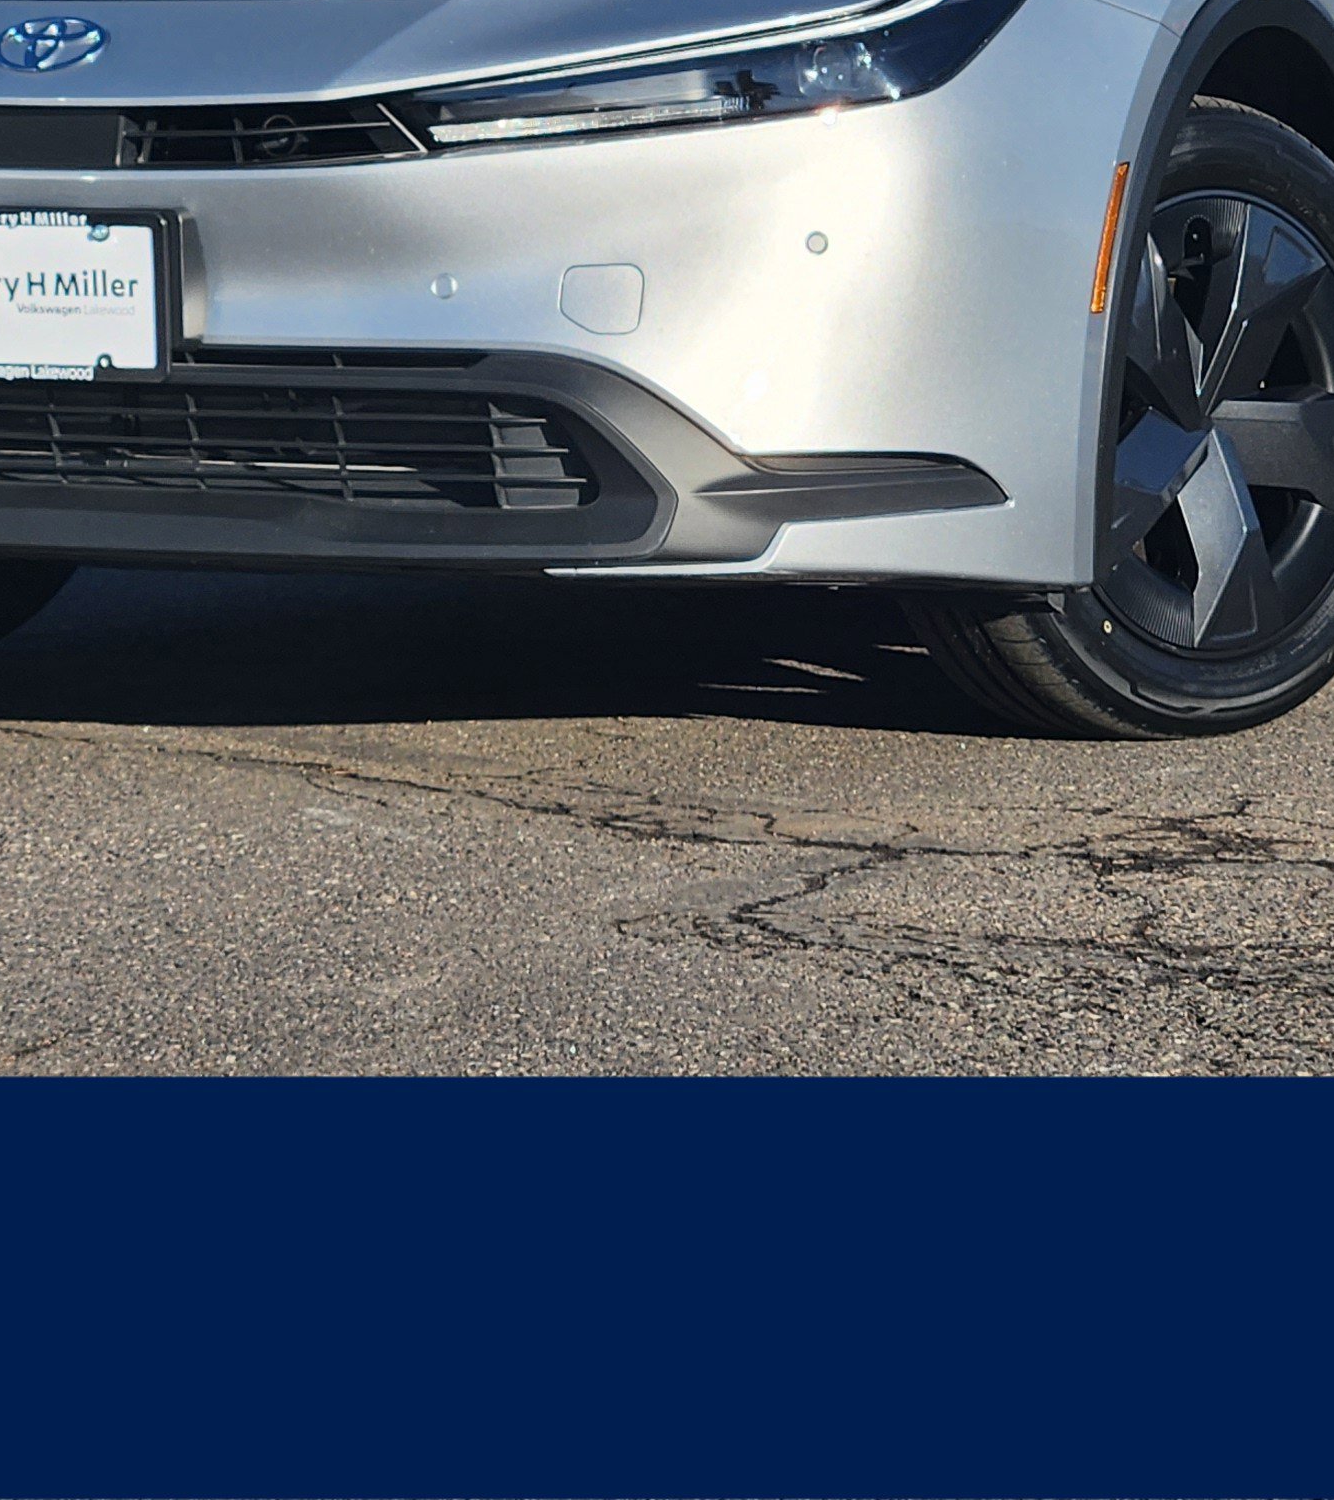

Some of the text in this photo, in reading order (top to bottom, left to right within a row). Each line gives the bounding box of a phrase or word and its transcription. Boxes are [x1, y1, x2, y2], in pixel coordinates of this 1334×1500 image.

[19, 211, 33, 226] H
[34, 211, 87, 227] Miller
[27, 272, 46, 296] H
[54, 269, 138, 297] Miller
[17, 303, 135, 317] Volkswagen Lakewood
